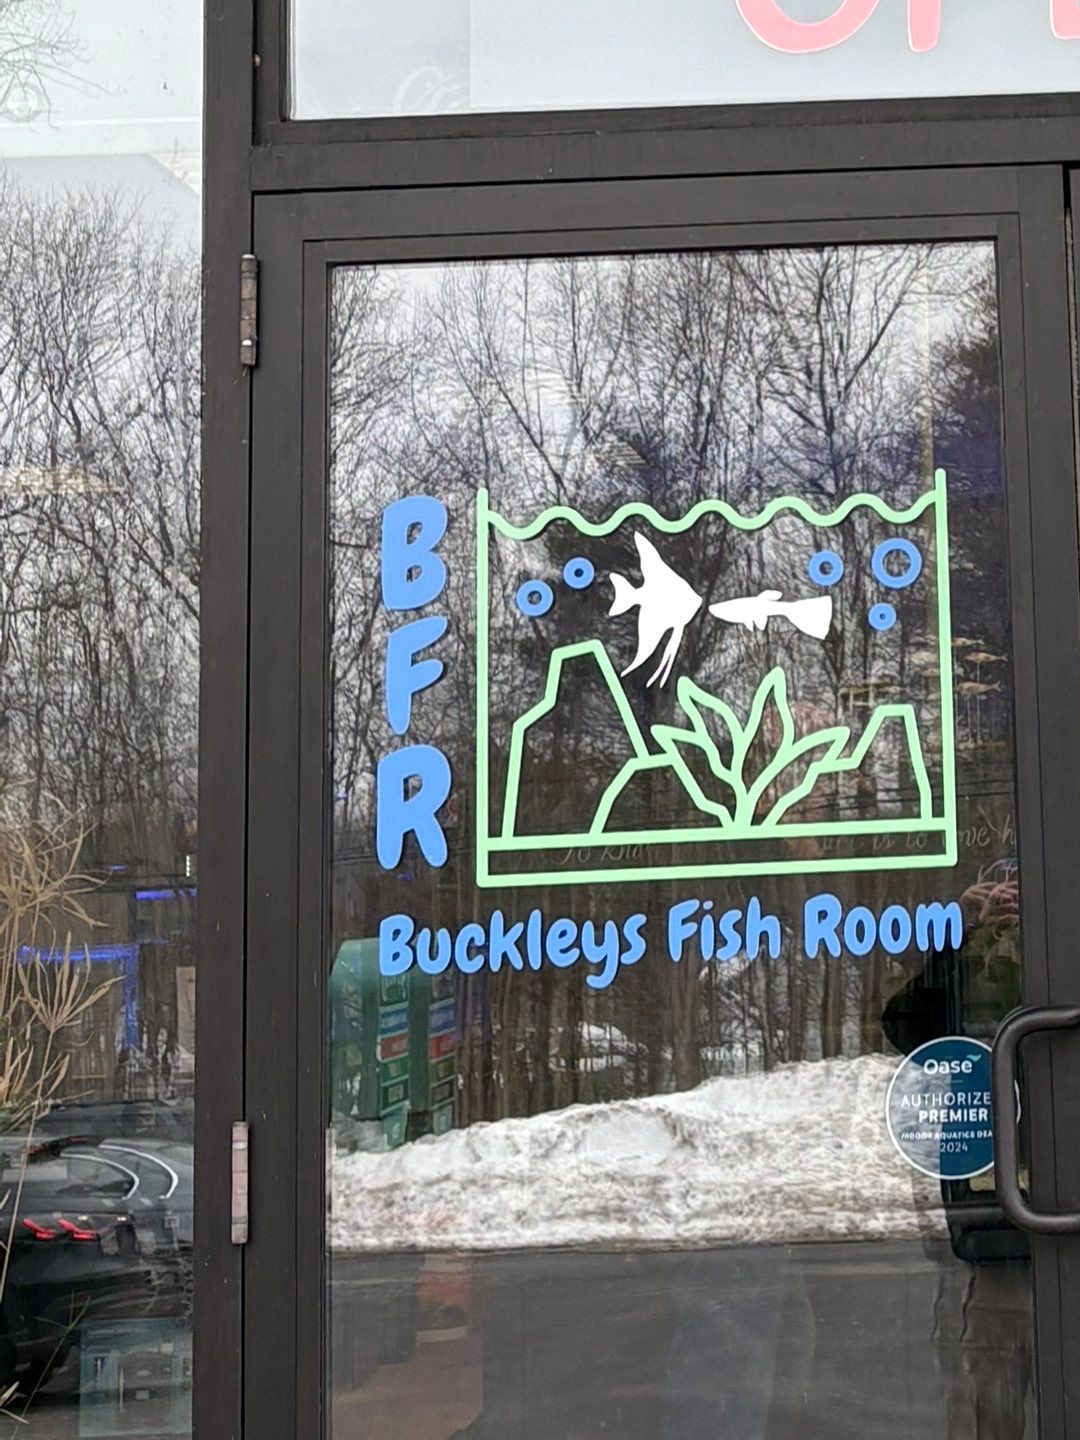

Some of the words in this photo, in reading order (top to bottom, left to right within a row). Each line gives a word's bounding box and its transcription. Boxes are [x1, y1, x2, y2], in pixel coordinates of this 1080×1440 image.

[378, 909, 647, 990] Buckleys
[668, 896, 782, 962] Fish
[803, 892, 964, 959] Room
[901, 1091, 992, 1108] AUTHORIZE
[919, 1109, 988, 1123] PREMIER
[933, 1130, 975, 1140] AQUATICS
[940, 1141, 969, 1153] 2024
